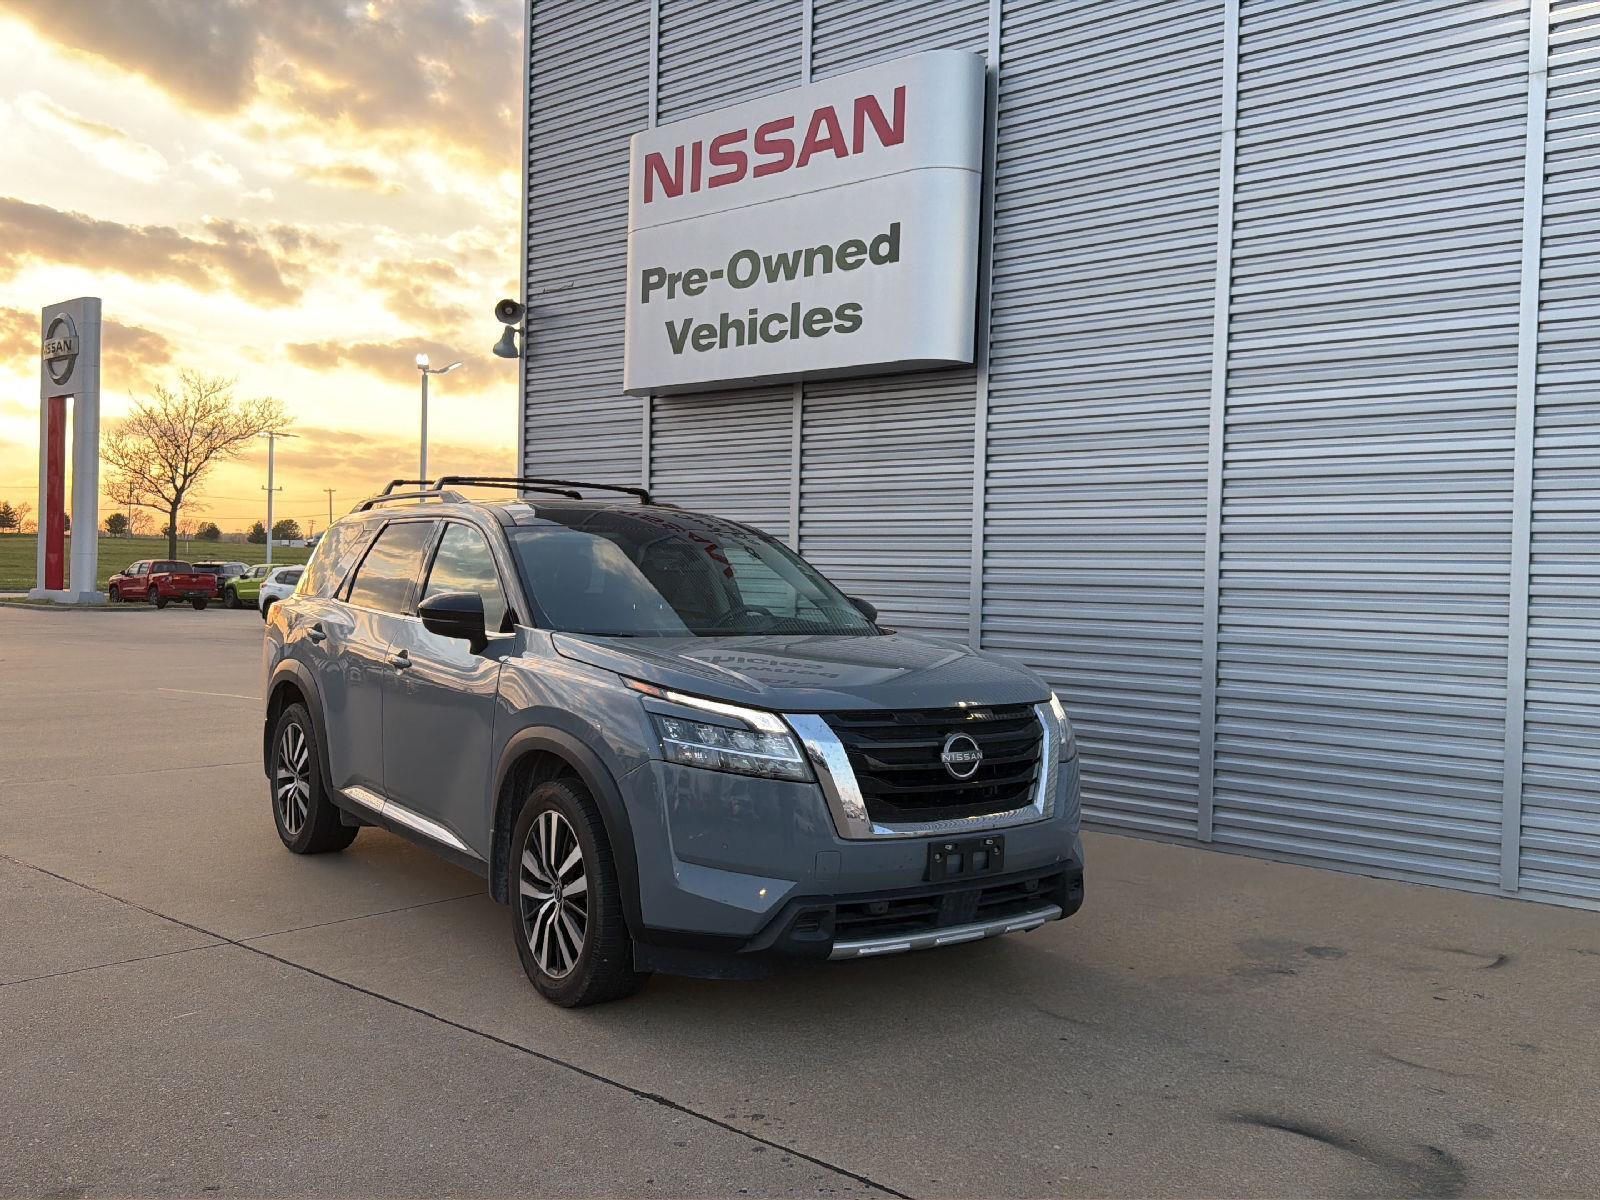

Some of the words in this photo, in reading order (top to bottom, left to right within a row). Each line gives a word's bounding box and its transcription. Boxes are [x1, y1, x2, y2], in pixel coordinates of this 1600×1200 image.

[643, 85, 907, 204] NISSAN
[641, 221, 901, 304] Pre-Owned
[664, 301, 863, 355] Vehicles
[943, 752, 983, 761] NISSAN
